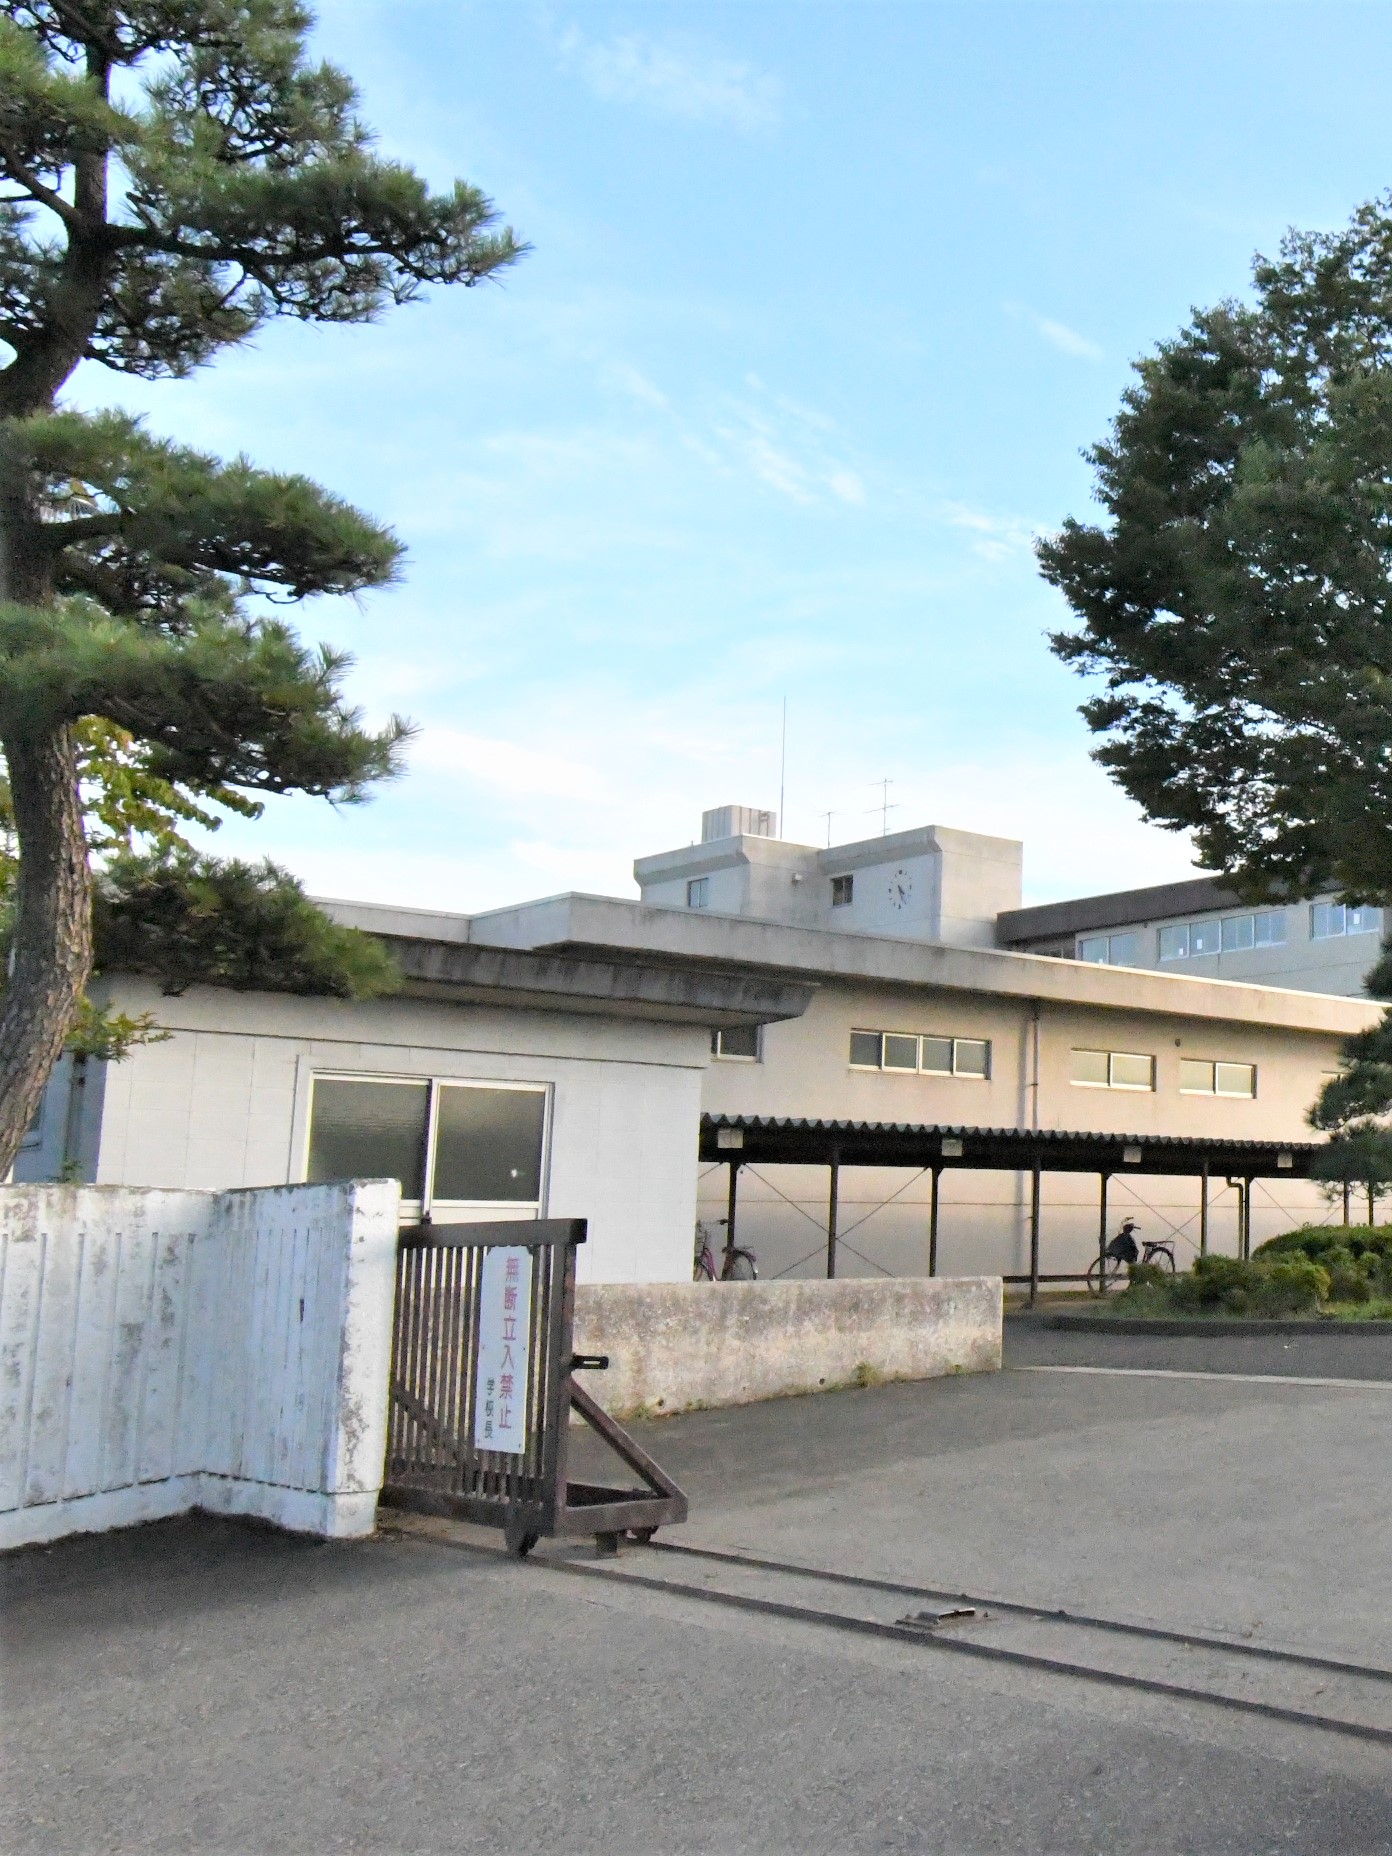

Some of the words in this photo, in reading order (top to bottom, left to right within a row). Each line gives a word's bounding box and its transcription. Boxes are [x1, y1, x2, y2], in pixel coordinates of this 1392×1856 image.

[499, 1256, 519, 1429] 無断立入禁止
